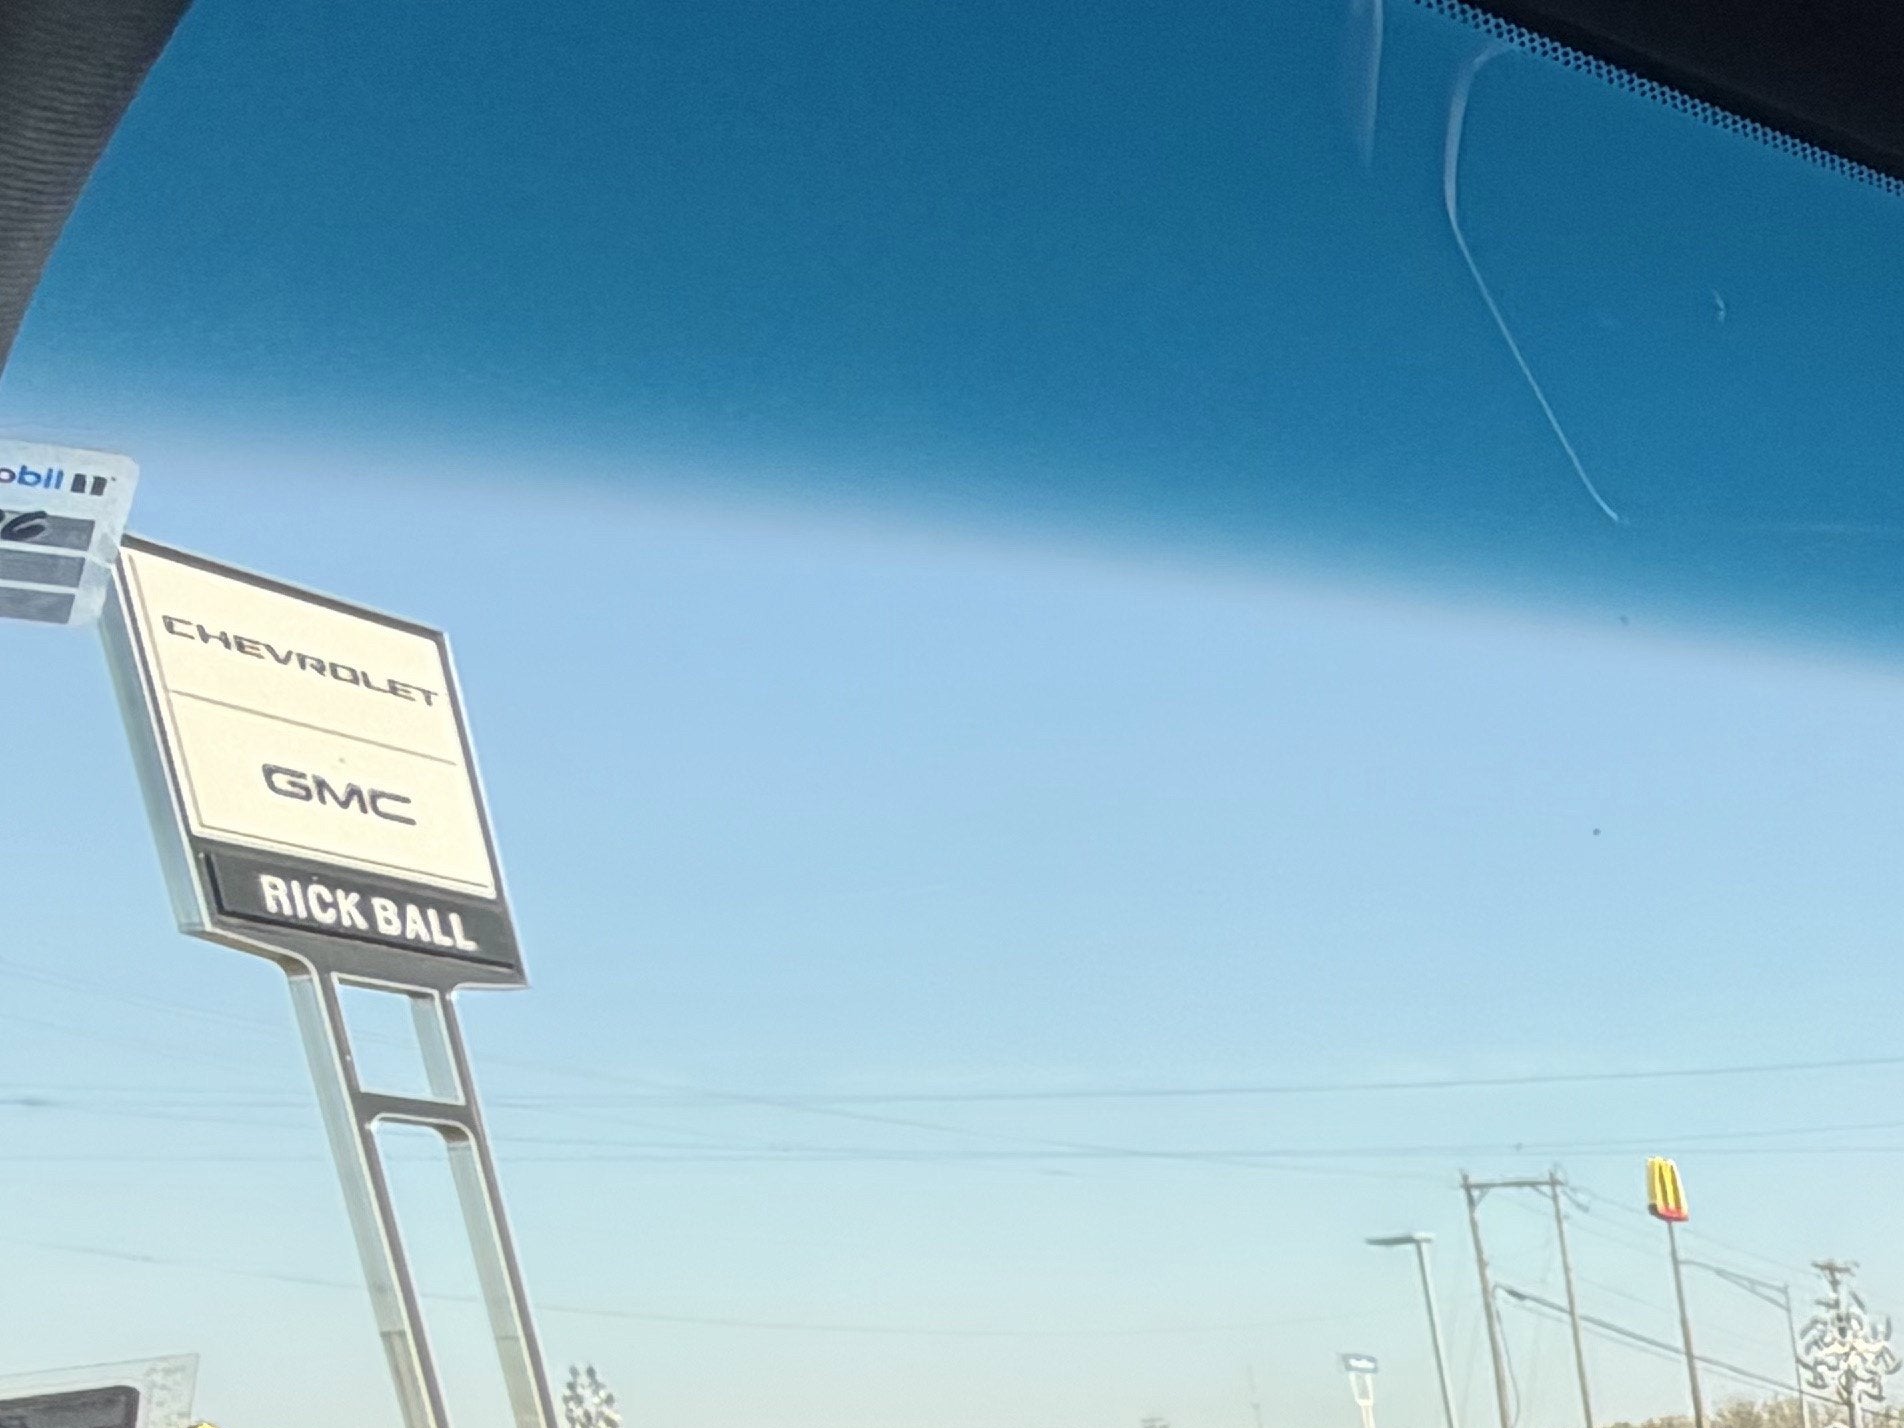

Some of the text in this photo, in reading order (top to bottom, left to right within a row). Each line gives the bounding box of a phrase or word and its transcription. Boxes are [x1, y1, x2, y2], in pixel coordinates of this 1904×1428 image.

[0, 464, 65, 490] obil
[161, 614, 440, 706] CHEVROLET
[261, 762, 417, 827] GMC
[259, 873, 480, 951] RICK BALL
